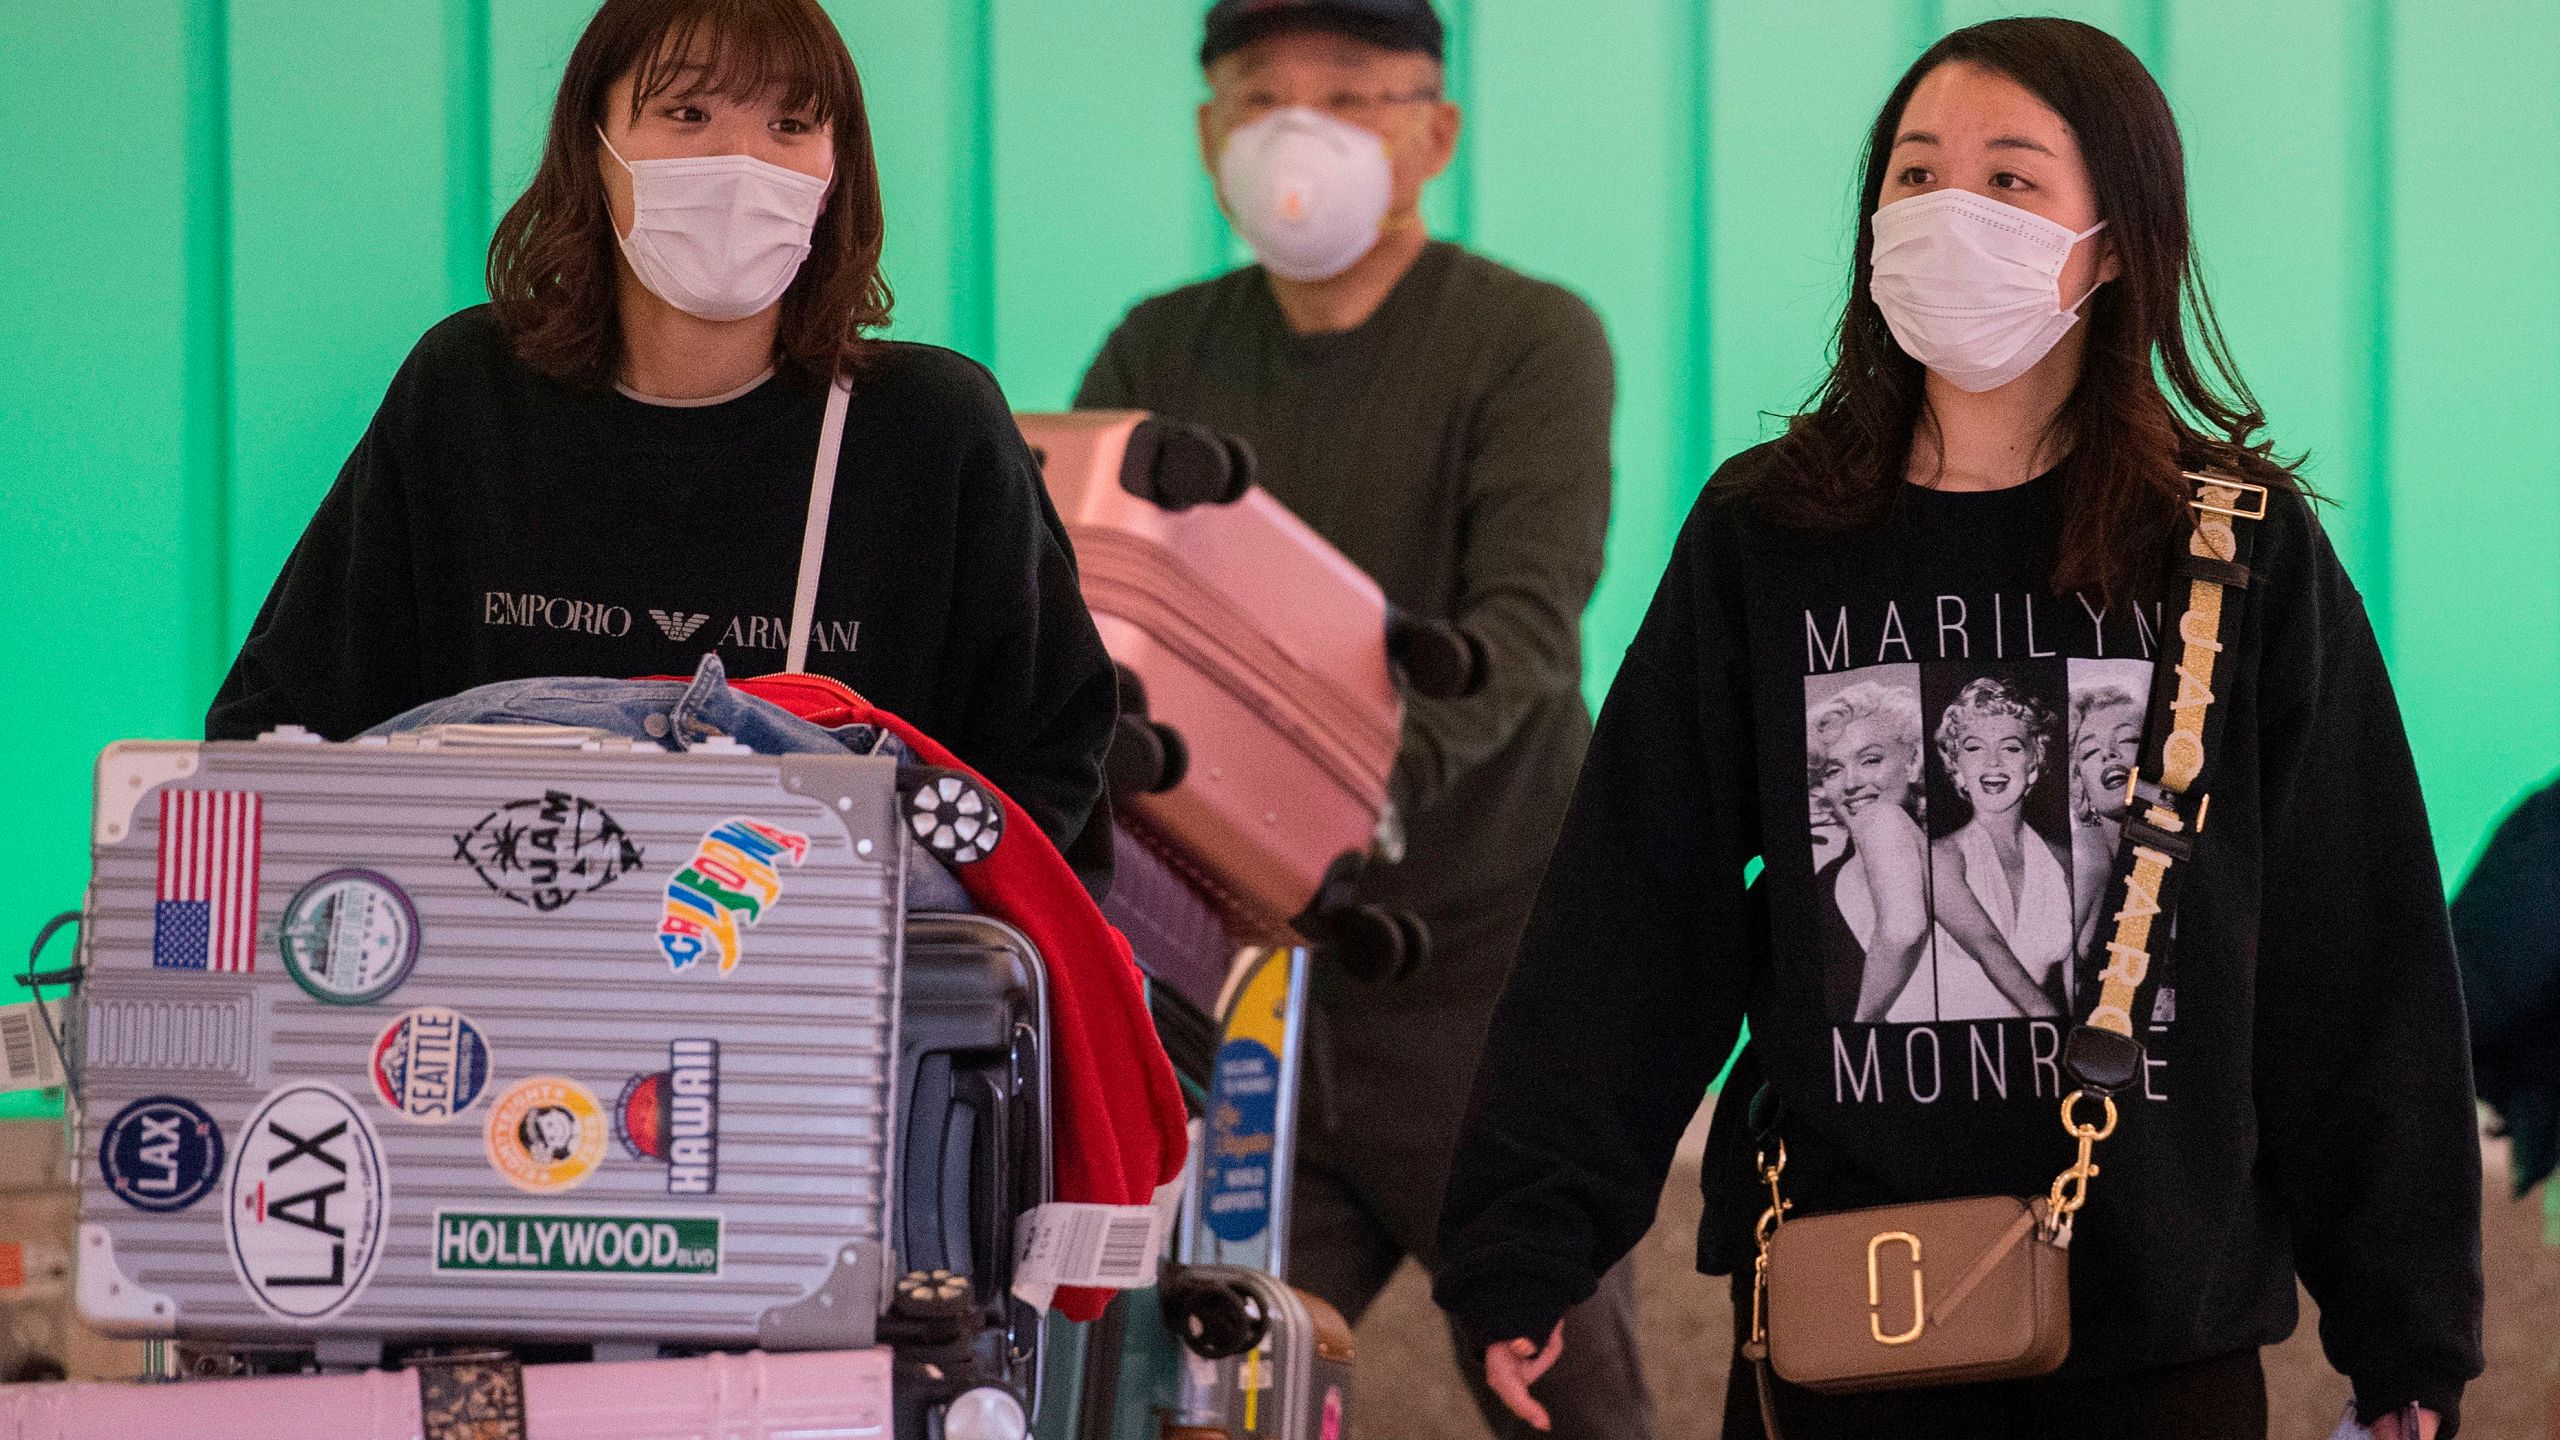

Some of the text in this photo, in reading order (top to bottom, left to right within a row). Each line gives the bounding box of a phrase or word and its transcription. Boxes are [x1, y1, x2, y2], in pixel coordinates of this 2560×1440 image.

[484, 591, 632, 638] EMPORIO
[718, 616, 862, 652] ARMANI
[1805, 592, 2163, 673] MARILYN
[2162, 609, 2224, 781] JAC
[530, 789, 573, 912] GUAM
[411, 1014, 453, 1116] SEATTLE
[1832, 1020, 2168, 1102] MONRE
[137, 1115, 181, 1191] LAX
[669, 1040, 712, 1194] HAWAII
[266, 1120, 347, 1287] LAX
[440, 1218, 715, 1267] HOLLYWOOD BLVD
